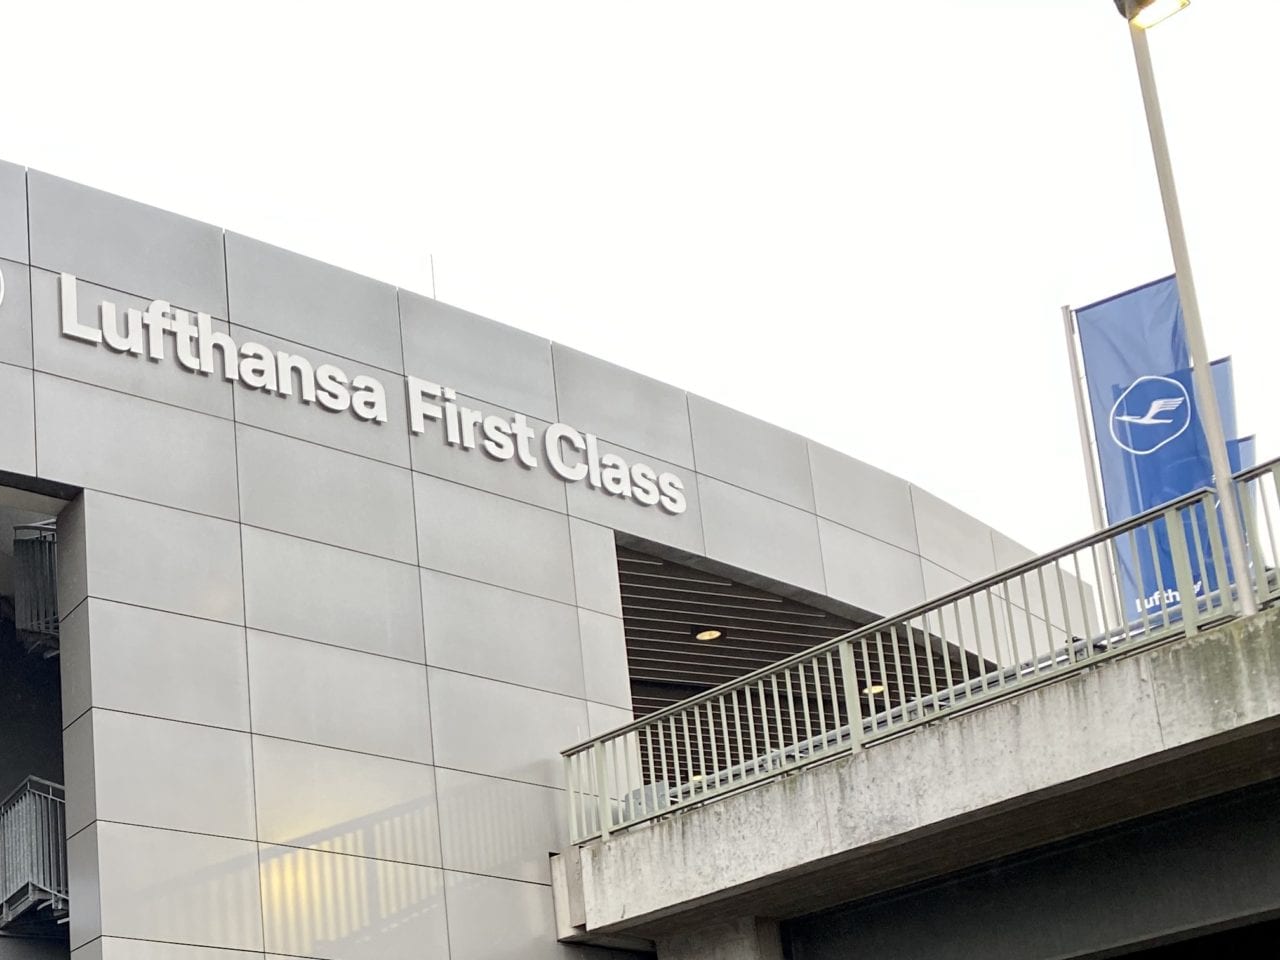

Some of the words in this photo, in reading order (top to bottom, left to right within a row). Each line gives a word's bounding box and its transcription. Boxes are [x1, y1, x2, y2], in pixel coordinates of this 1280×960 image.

[59, 272, 387, 424] Lufthansa
[406, 376, 538, 469] First
[545, 423, 687, 515] Class
[1135, 580, 1202, 613] Lufth
